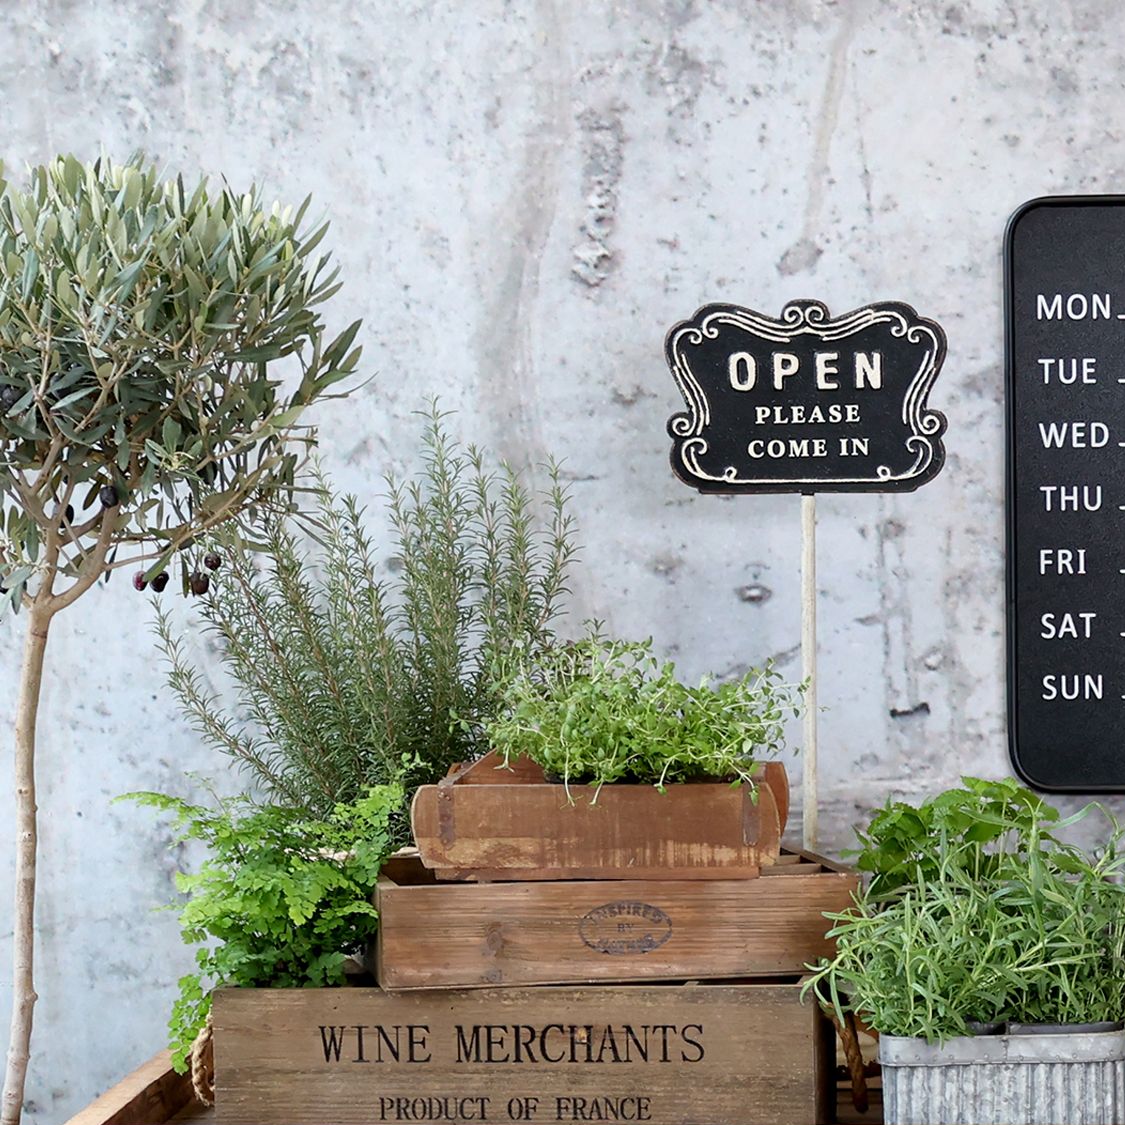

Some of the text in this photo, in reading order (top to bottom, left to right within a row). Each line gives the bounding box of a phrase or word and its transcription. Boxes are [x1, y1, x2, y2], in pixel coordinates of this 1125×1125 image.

[1037, 294, 1111, 320] MON
[729, 351, 882, 391] OPEN
[1037, 358, 1097, 385] TUE
[755, 404, 861, 425] PLEASE
[1038, 423, 1110, 448] WED
[747, 438, 870, 459] COME IN
[1039, 486, 1102, 512] THU
[1040, 550, 1087, 575] FRI
[1040, 613, 1097, 639] SAT
[1041, 675, 1103, 700] SUN
[318, 1024, 705, 1063] WINE MERCHANTS
[379, 1097, 652, 1121] PRODUCT OF FRANCE
